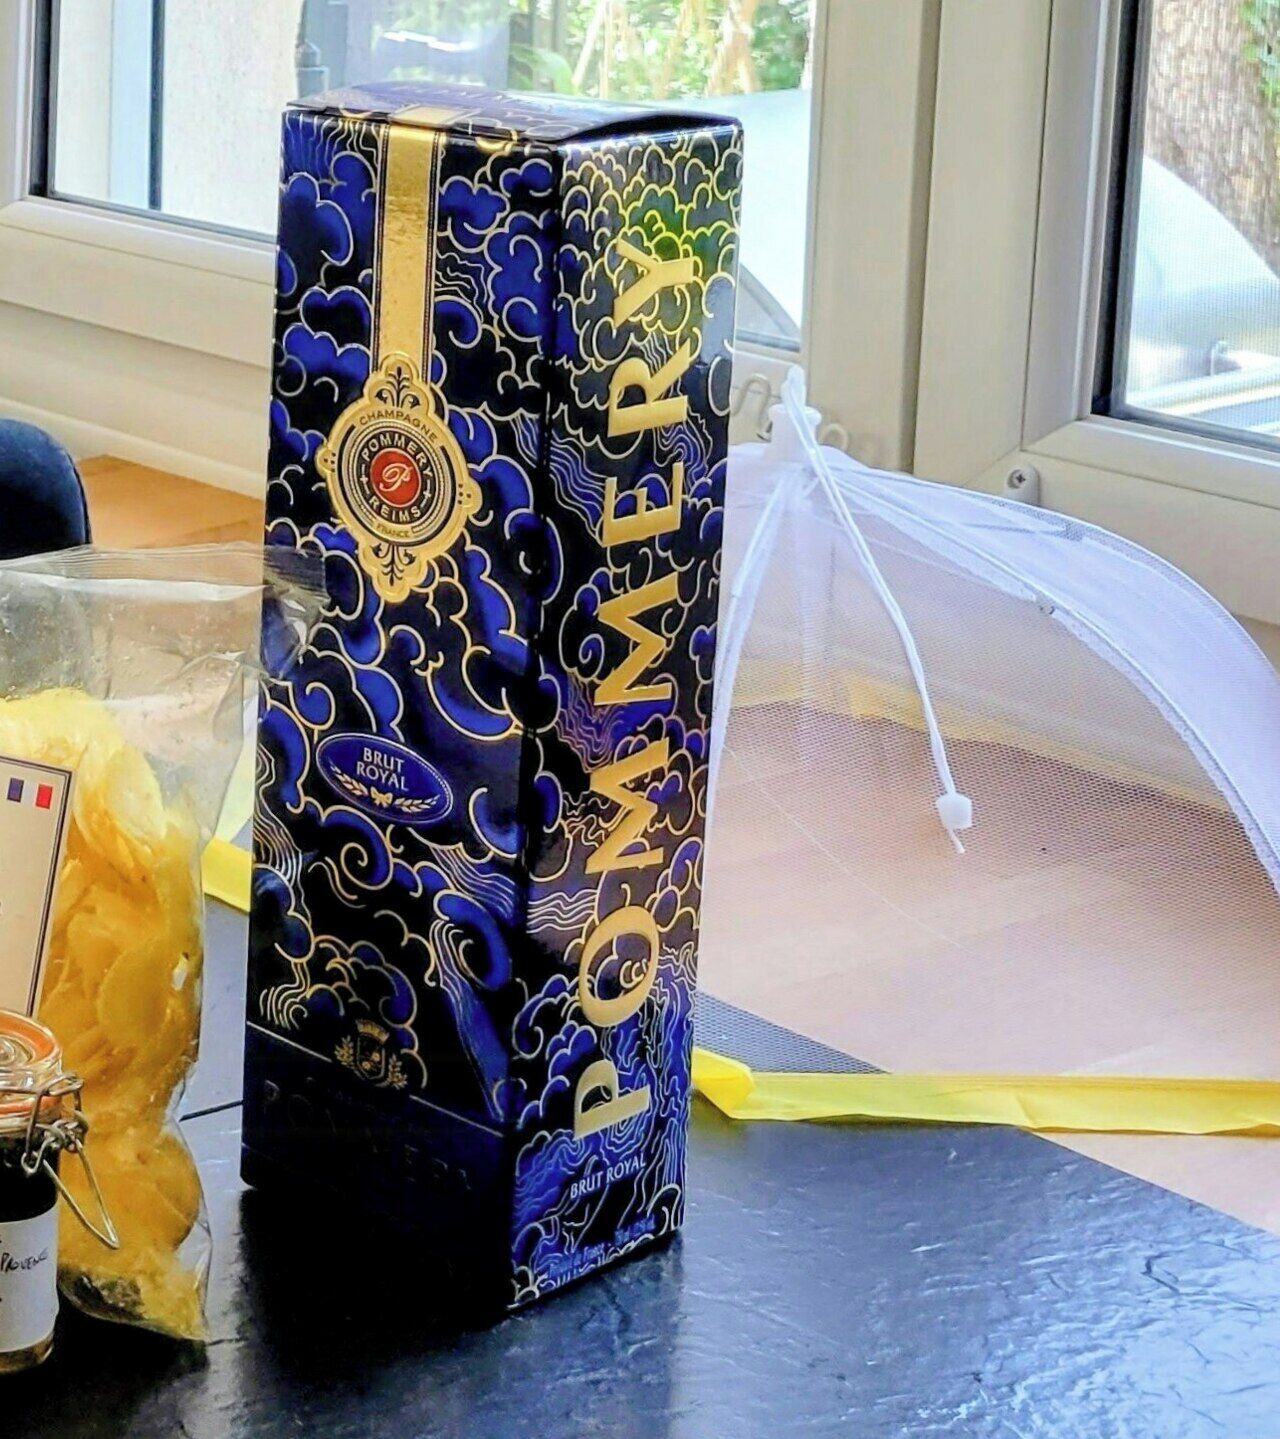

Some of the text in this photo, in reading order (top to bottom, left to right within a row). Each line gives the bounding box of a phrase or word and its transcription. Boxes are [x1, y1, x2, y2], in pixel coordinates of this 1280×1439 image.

[359, 410, 438, 443] CHAMPAGNE
[361, 432, 433, 477] POMMERY
[368, 495, 422, 522] REIMS
[573, 236, 694, 1142] POMMERY
[356, 761, 410, 792] ROYAL
[363, 747, 405, 773] BRUT
[570, 1152, 647, 1200] BRUT ROYAL
